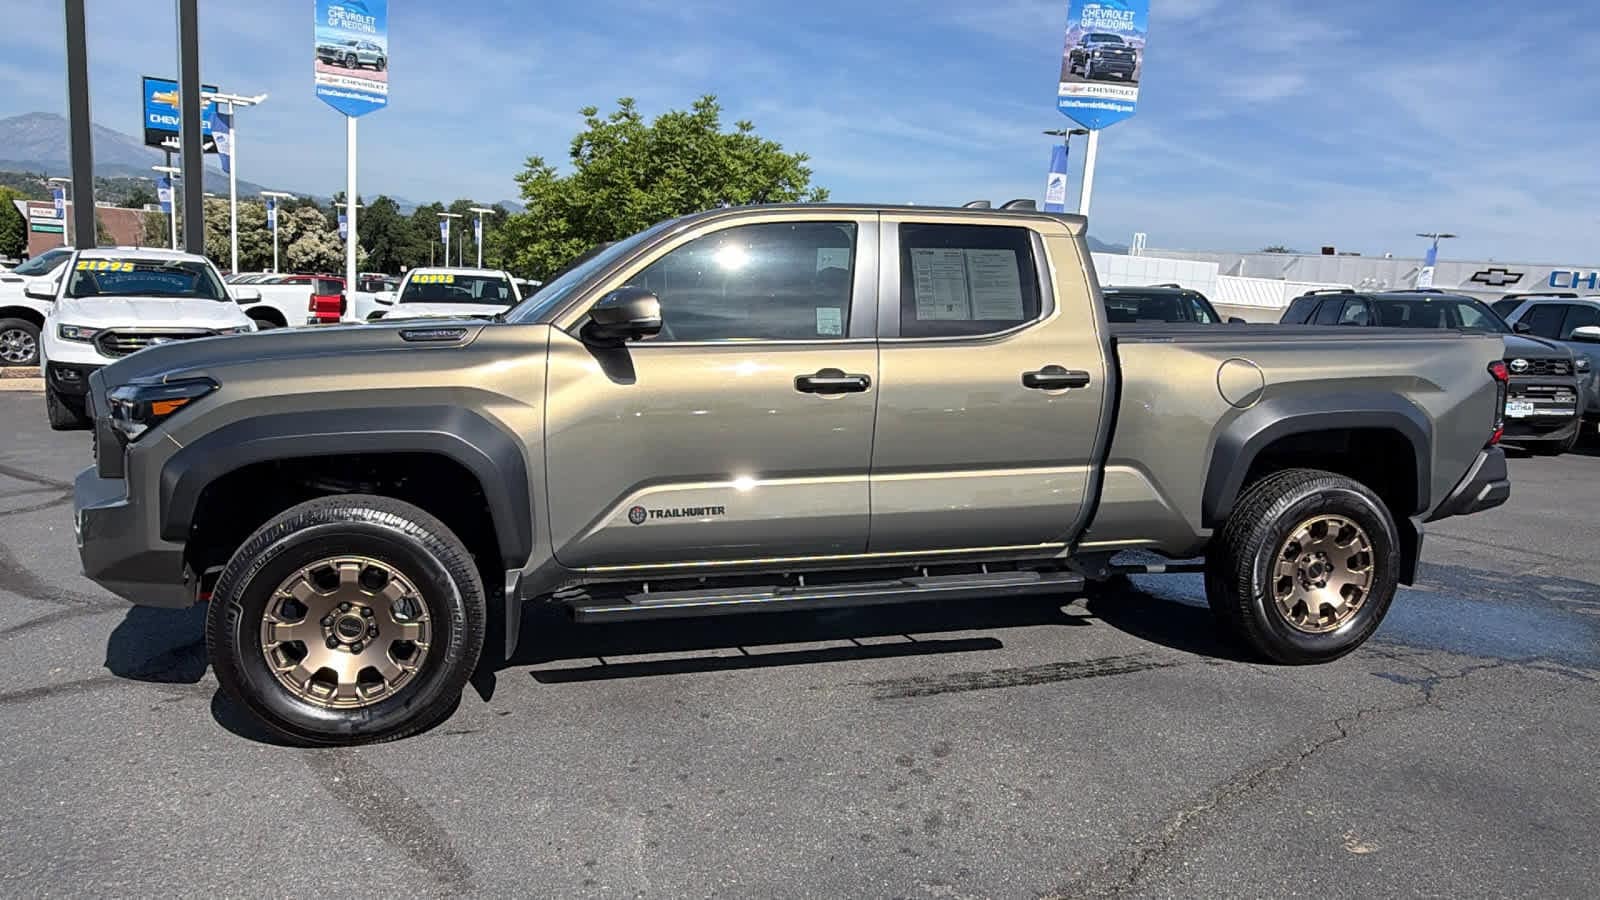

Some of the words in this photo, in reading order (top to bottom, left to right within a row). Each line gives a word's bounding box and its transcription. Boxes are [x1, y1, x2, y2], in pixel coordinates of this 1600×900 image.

[328, 9, 376, 24] CHEVROLET
[1082, 8, 1135, 21] CHEVROLET
[328, 17, 339, 27] OF
[341, 20, 376, 32] REDDING
[1081, 18, 1095, 27] OF
[1096, 19, 1134, 30] REDDING
[342, 78, 384, 90] CHEVROLET
[1087, 86, 1134, 96] CHEVROLET
[150, 114, 211, 129] CHEVET
[76, 260, 134, 272] 21995
[1549, 271, 1600, 289] CH
[648, 506, 725, 519] TRAILHUNTER
